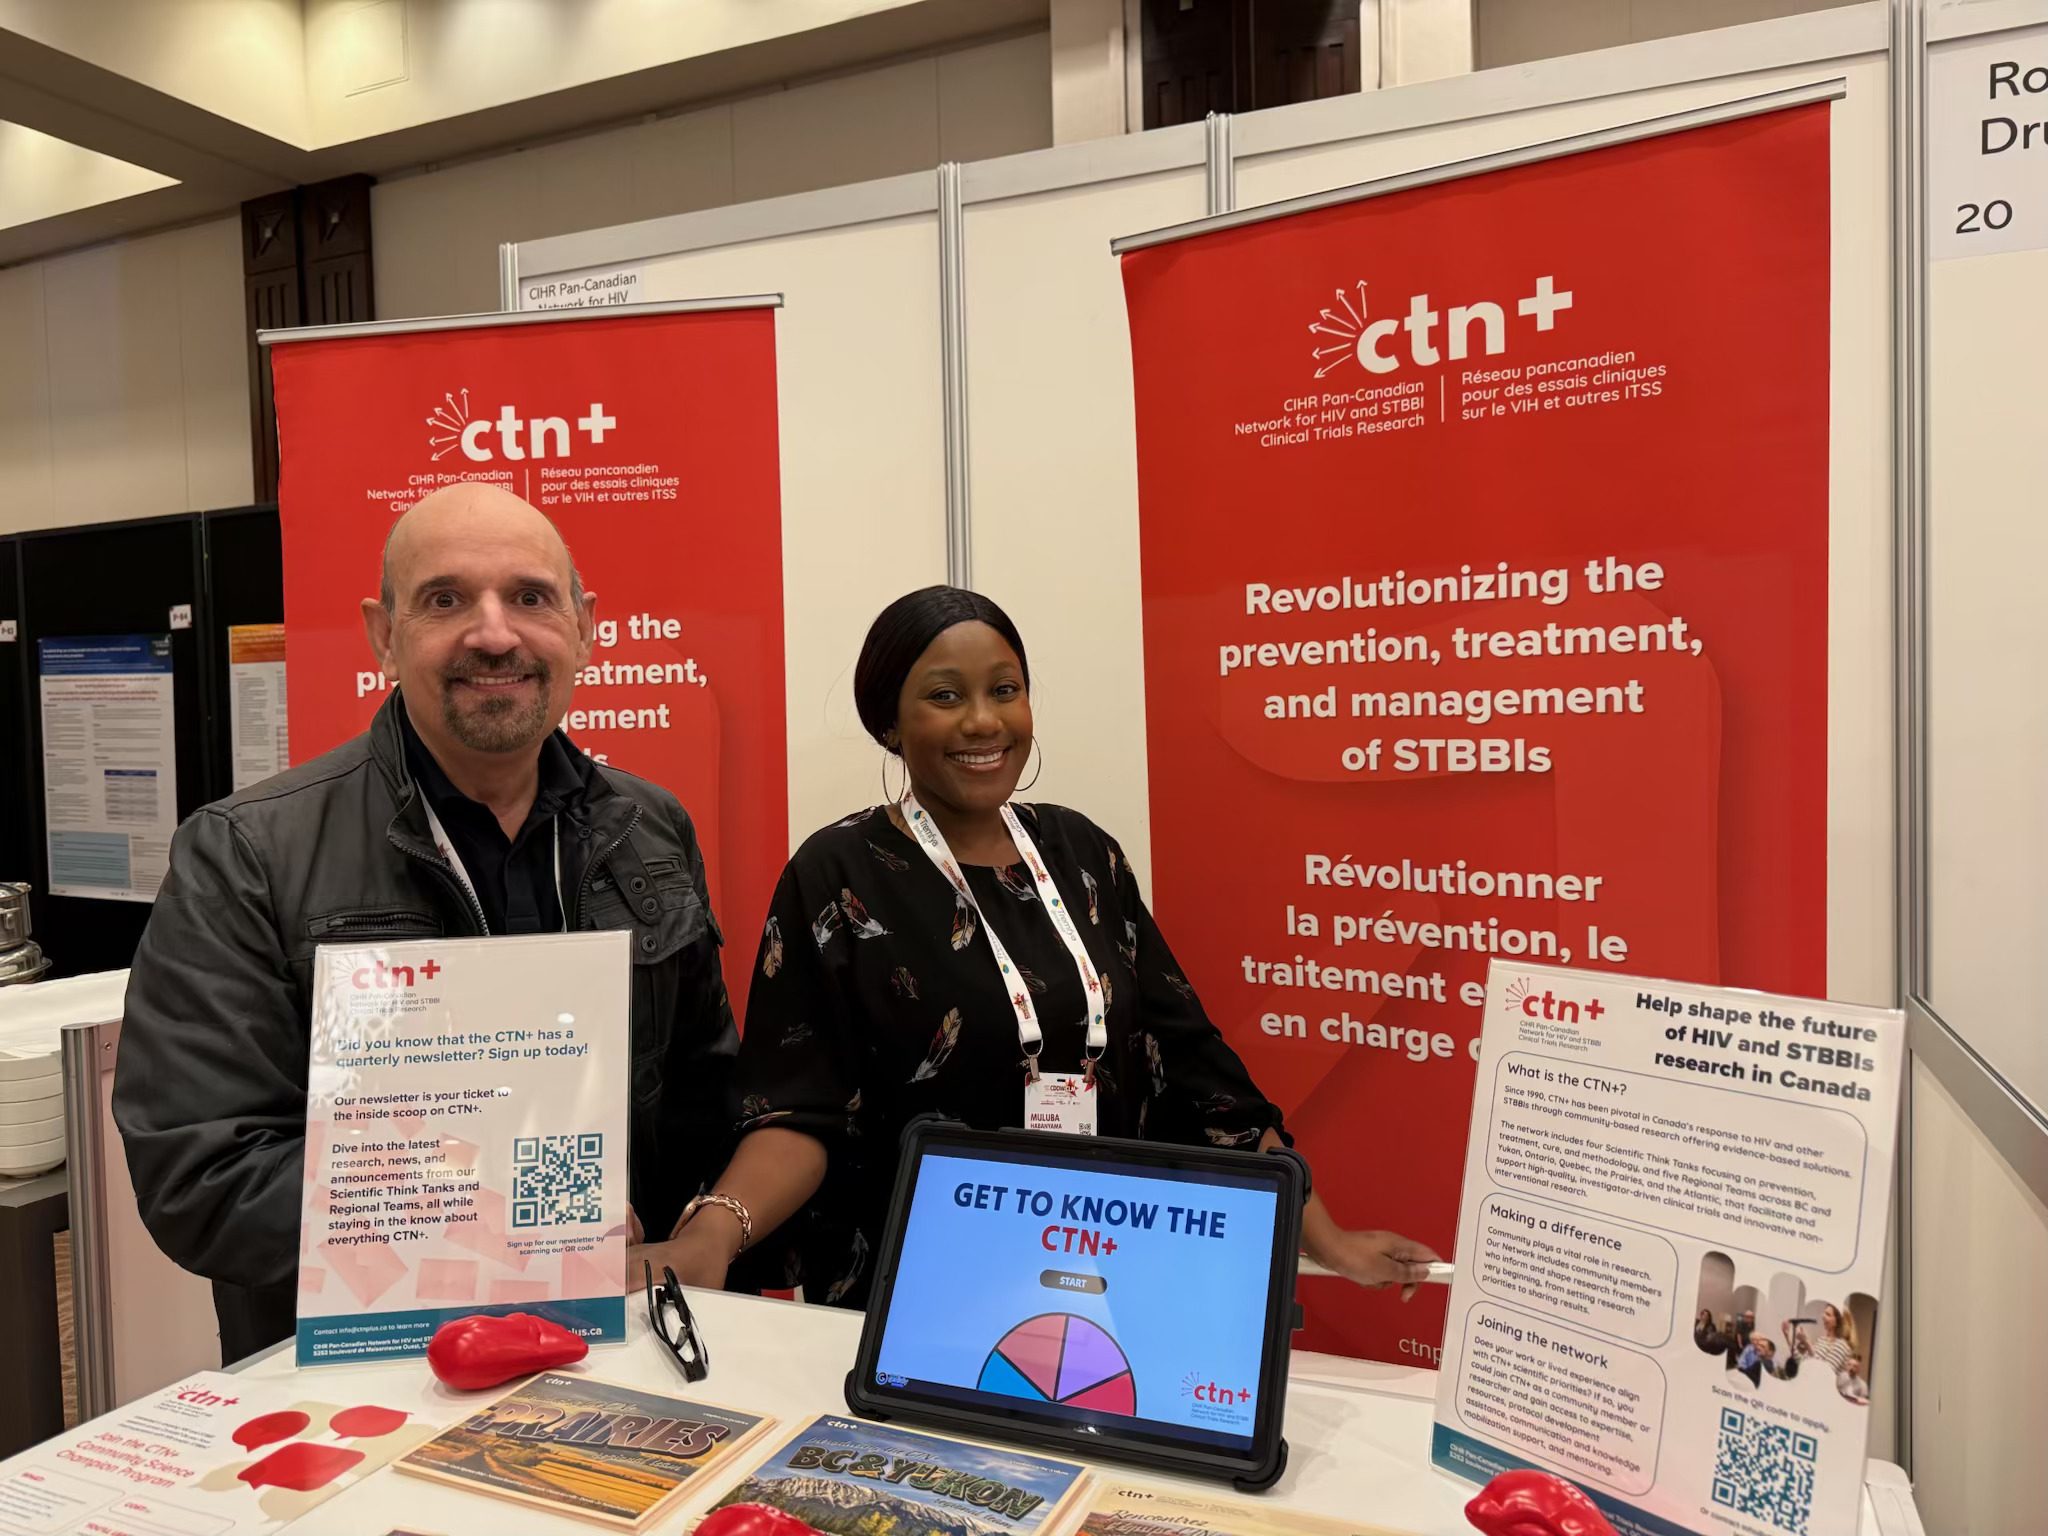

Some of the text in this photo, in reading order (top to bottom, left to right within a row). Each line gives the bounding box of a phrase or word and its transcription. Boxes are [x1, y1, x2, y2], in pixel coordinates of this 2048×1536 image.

[1956, 200, 2013, 234] 20
[529, 274, 637, 301] CIHR Pan-Canadian
[608, 290, 629, 305] HIV
[1357, 275, 1573, 374] ctn+
[1461, 352, 1634, 385] Réseau pancanadien
[1283, 381, 1424, 412] CIHR Pan-Canadian
[1461, 364, 1667, 406] pour des essais cliniques
[1462, 380, 1662, 421] sur le VIH et autres ITSS
[1234, 396, 1425, 435] Network for HIV and STBBI
[1260, 413, 1425, 448] Clinical Trials Research
[461, 403, 617, 462] ctn+
[408, 470, 513, 486] CIHR Pan-Canadian
[540, 463, 659, 479] Réseau pancanadien
[541, 476, 680, 494] pour des essais cliniques
[367, 489, 415, 500] Network
[541, 487, 677, 505] sur le VIH et autres ITSS
[1247, 557, 1663, 615] Revolutionizing the
[628, 613, 681, 639] the
[1220, 617, 1702, 676] prevention, treatment,
[1264, 679, 1644, 724] and management
[1342, 739, 1551, 772] of STBBIs
[919, 817, 939, 848] Tremfya
[1306, 855, 1602, 901] Révolutionner
[1287, 905, 1627, 962] la prévention, le
[352, 959, 441, 990] ctn+
[1242, 956, 1485, 1007] traitement e
[1522, 990, 1605, 1024] ctn+
[1636, 992, 1877, 1042] Help shape the future
[365, 1039, 391, 1053] you
[395, 1036, 434, 1048] know
[437, 1033, 465, 1046] that
[468, 1032, 492, 1045] the
[494, 1029, 534, 1043] CTN+
[537, 1029, 562, 1041] has
[565, 1030, 574, 1039] a
[1260, 1012, 1454, 1061] en charge
[1664, 1025, 1874, 1072] of HIV and STBBIs
[335, 1042, 588, 1068] quarterly newsletter? Sign up today!
[1507, 1062, 1627, 1096] What is the CTN+?
[1655, 1053, 1870, 1101] research in Canada
[333, 1103, 482, 1121] the inside scoop on CTN+.
[334, 1097, 357, 1106] Our
[359, 1093, 420, 1105] newsletter
[422, 1091, 432, 1102] is
[434, 1092, 461, 1104] your
[462, 1088, 495, 1100] ticket
[1030, 1113, 1060, 1122] MULUBA
[332, 1139, 441, 1154] Dive into the latest
[329, 1181, 480, 1200] Scientific Think Tanks and
[328, 1212, 478, 1232] staying in the know about
[329, 1197, 474, 1217] Regional Teams, all while
[954, 1183, 1226, 1238] GET TO KNOW THE
[327, 1230, 429, 1247] everything CTN+.
[1042, 1225, 1117, 1256] CTN+
[1490, 1203, 1622, 1250] Making a difference
[1059, 1276, 1088, 1289] START
[1478, 1315, 1607, 1368] Joining the network
[545, 1376, 572, 1387] ctn+
[1194, 1383, 1252, 1406] ctn+
[177, 1389, 240, 1407] ctn+
[466, 1401, 732, 1459] PRAIRIES
[827, 1419, 858, 1431] ctn+
[76, 1441, 195, 1478] Community Science
[95, 1432, 179, 1457] Join the CTN+
[56, 1449, 176, 1489] Champion Program
[1118, 1488, 1154, 1500] ctn+
